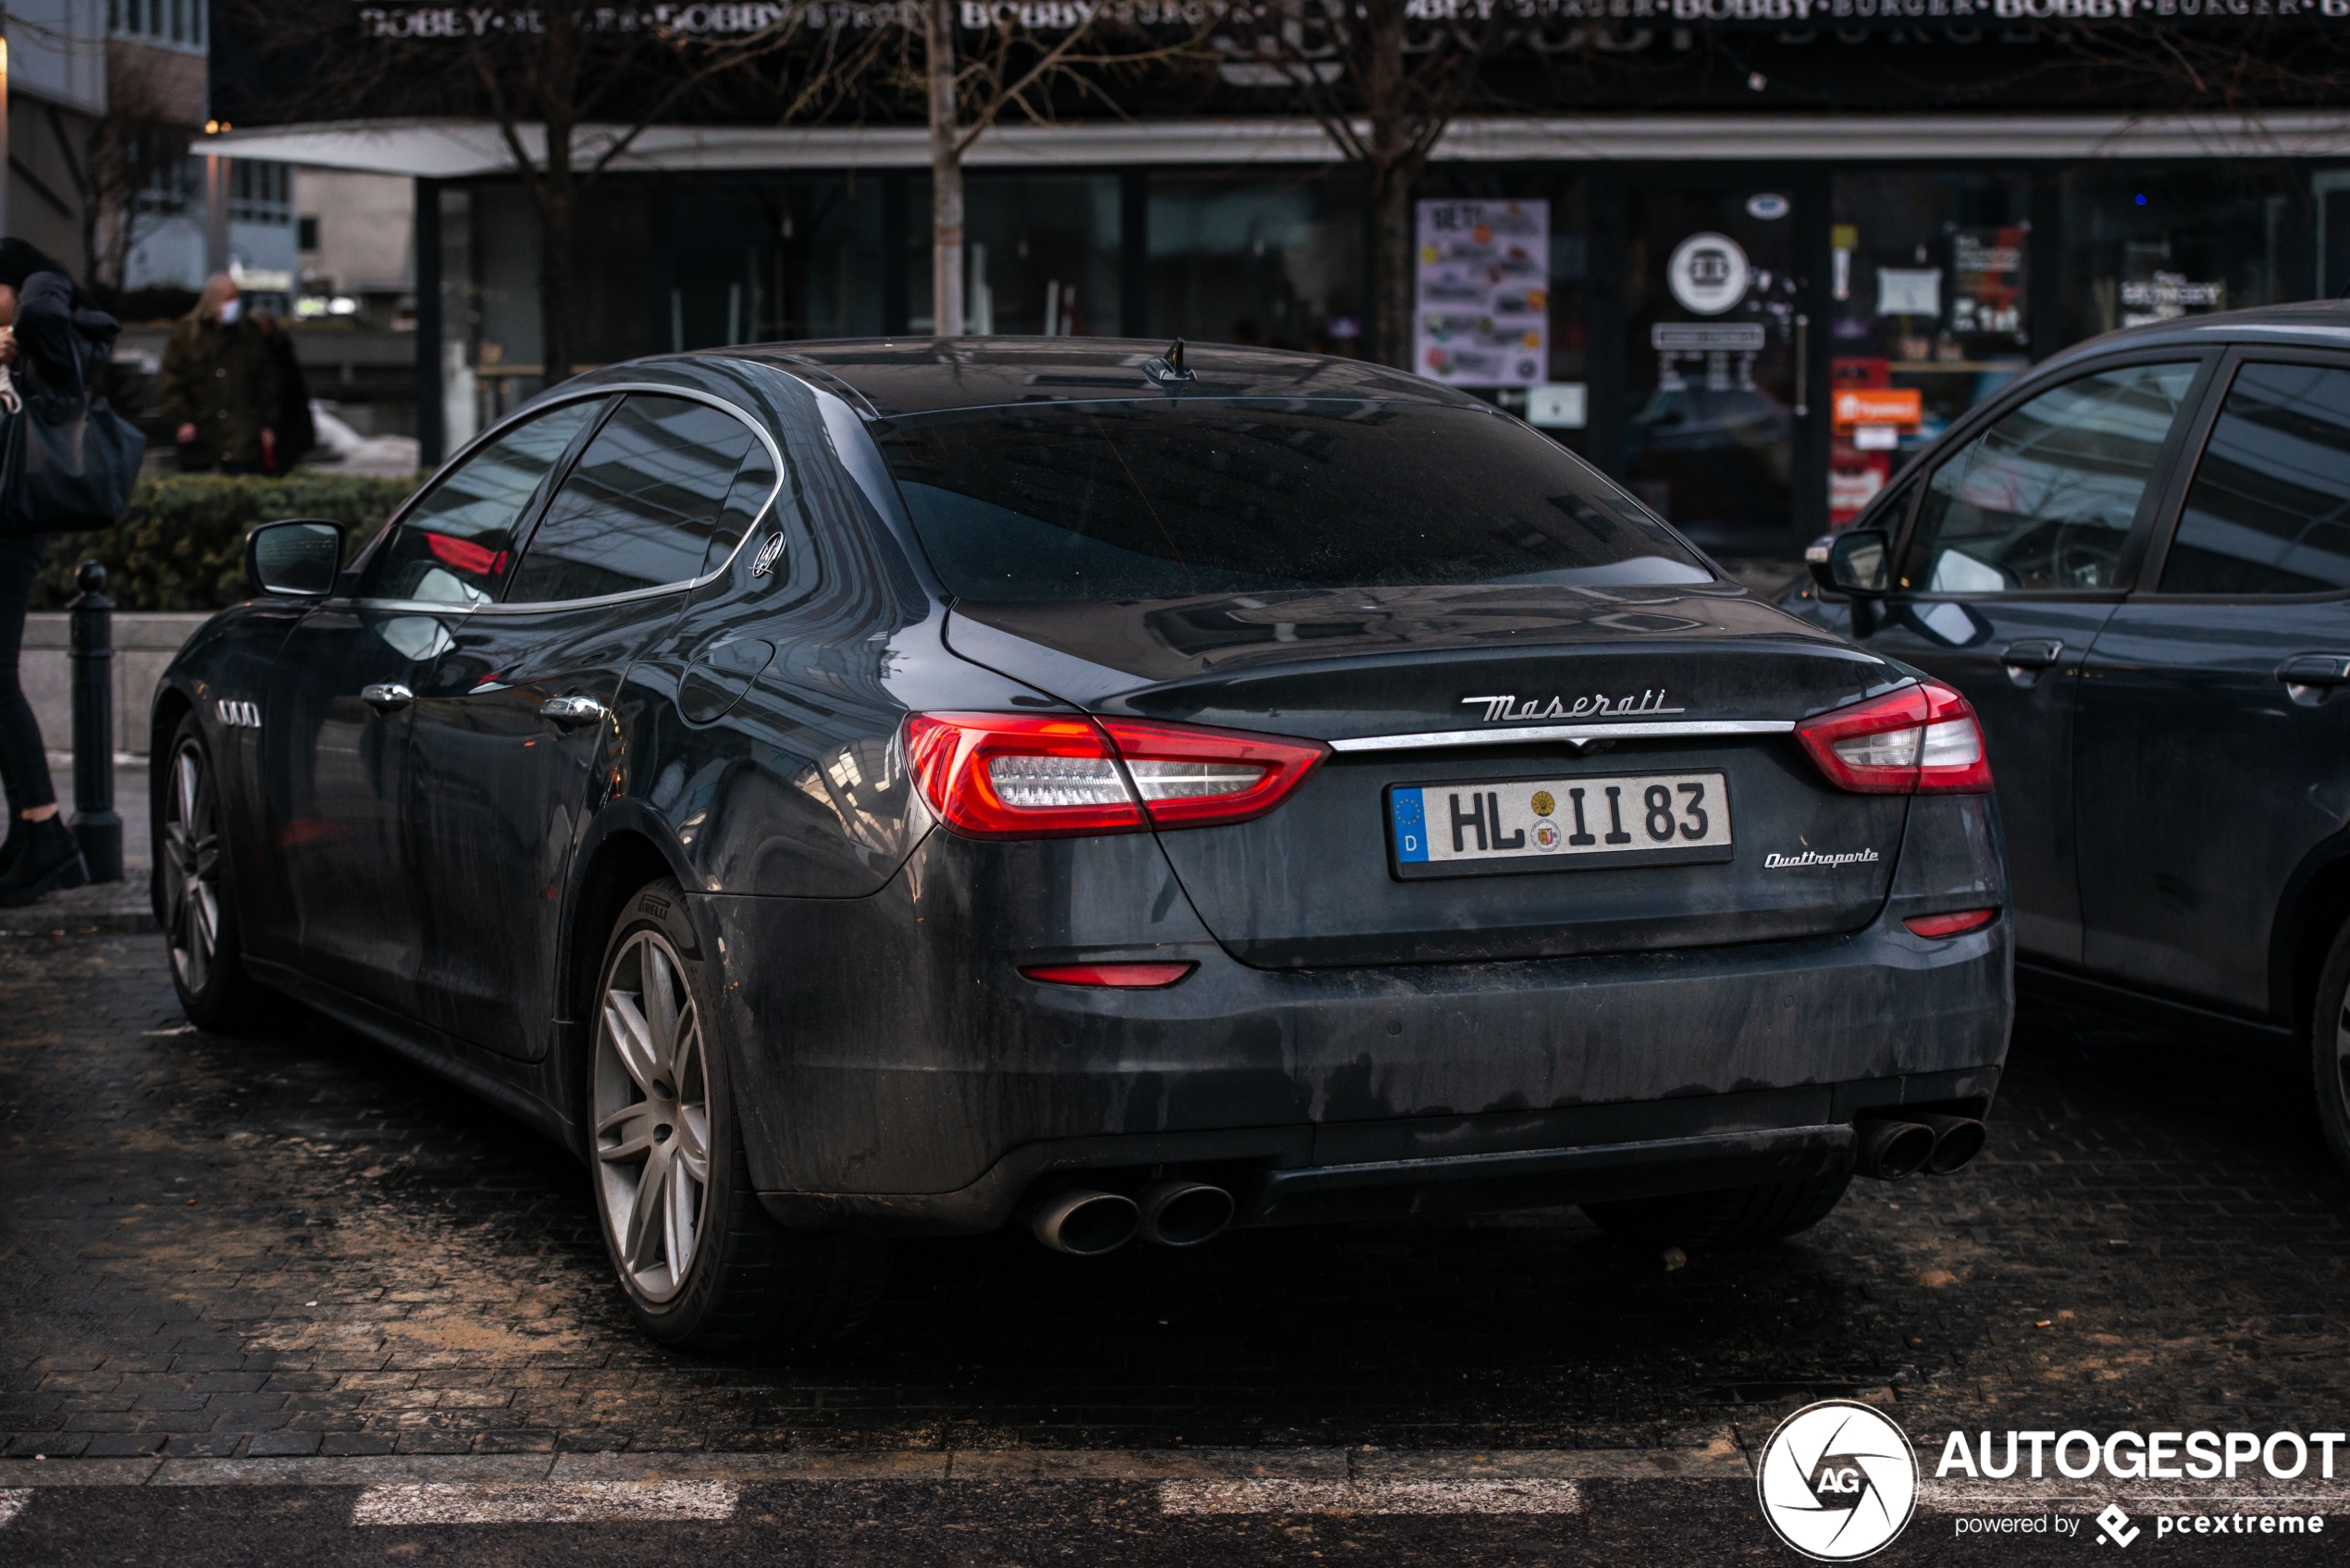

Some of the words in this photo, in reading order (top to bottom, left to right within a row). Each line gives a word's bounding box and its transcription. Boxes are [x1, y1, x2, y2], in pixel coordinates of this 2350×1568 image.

[1462, 689, 1685, 722] Maserati
[1449, 792, 1526, 852] HL
[1644, 783, 1709, 842] 83
[1404, 834, 1417, 852] D
[1763, 847, 1879, 870] Quattroporte
[637, 894, 672, 920] PIRELLI
